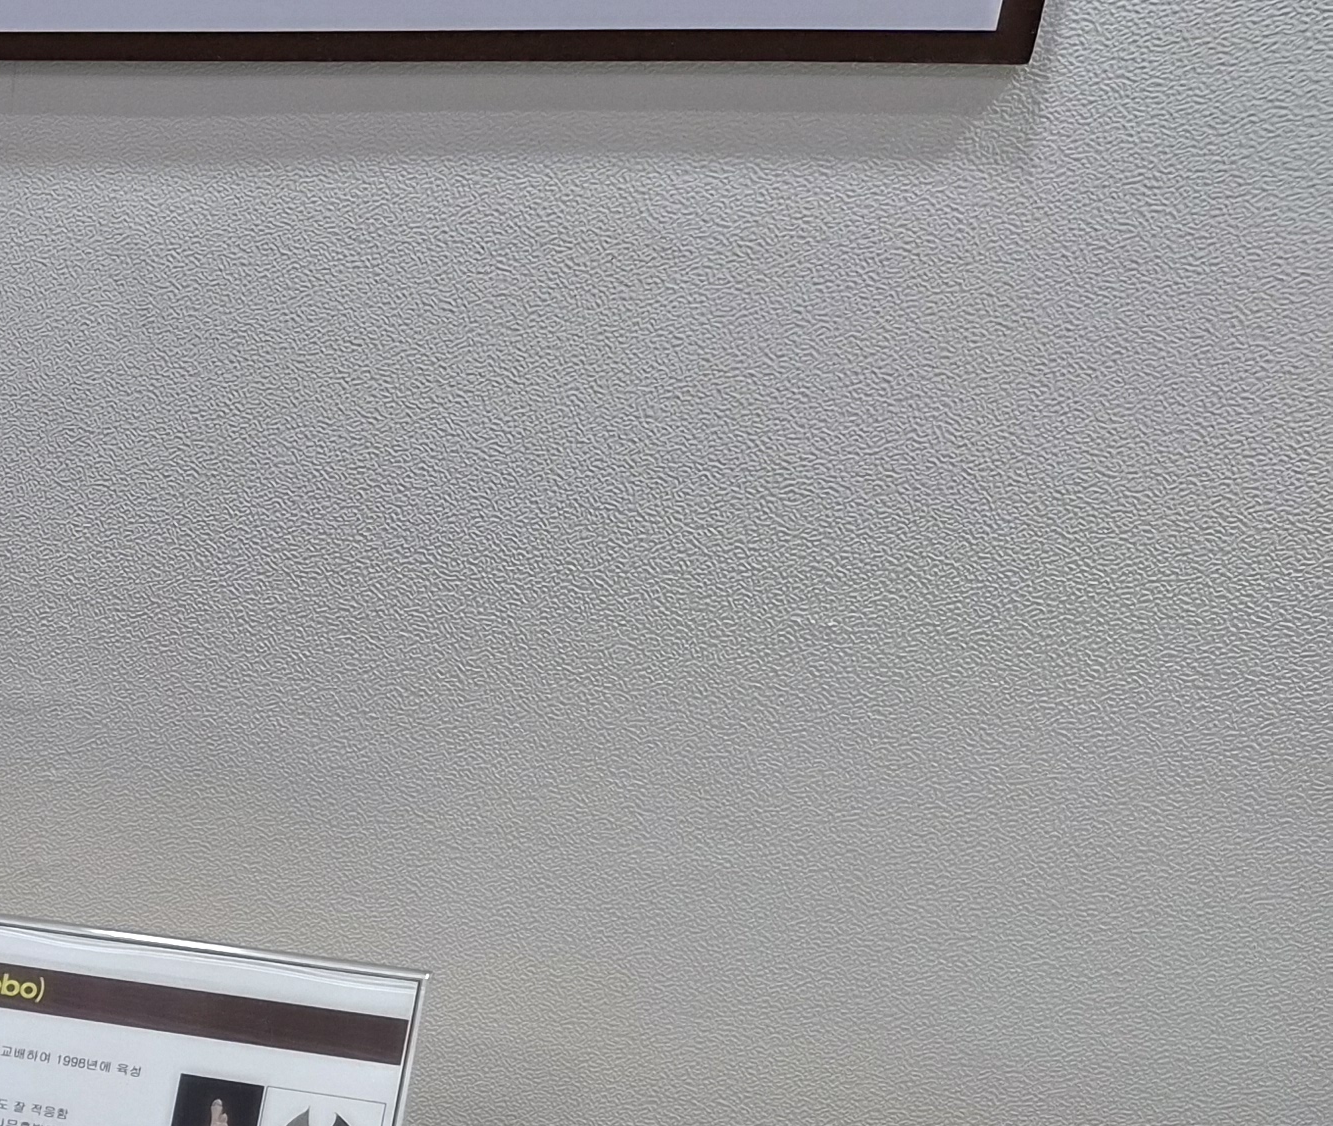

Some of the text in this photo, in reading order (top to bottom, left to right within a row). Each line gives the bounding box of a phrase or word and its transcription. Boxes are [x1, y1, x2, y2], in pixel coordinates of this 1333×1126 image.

[0, 1045, 51, 1064] 교배하여
[57, 1054, 112, 1073] 1998년에
[116, 1063, 142, 1078] 육성
[13, 1100, 26, 1114] 잘
[31, 1103, 69, 1120] 적응함
